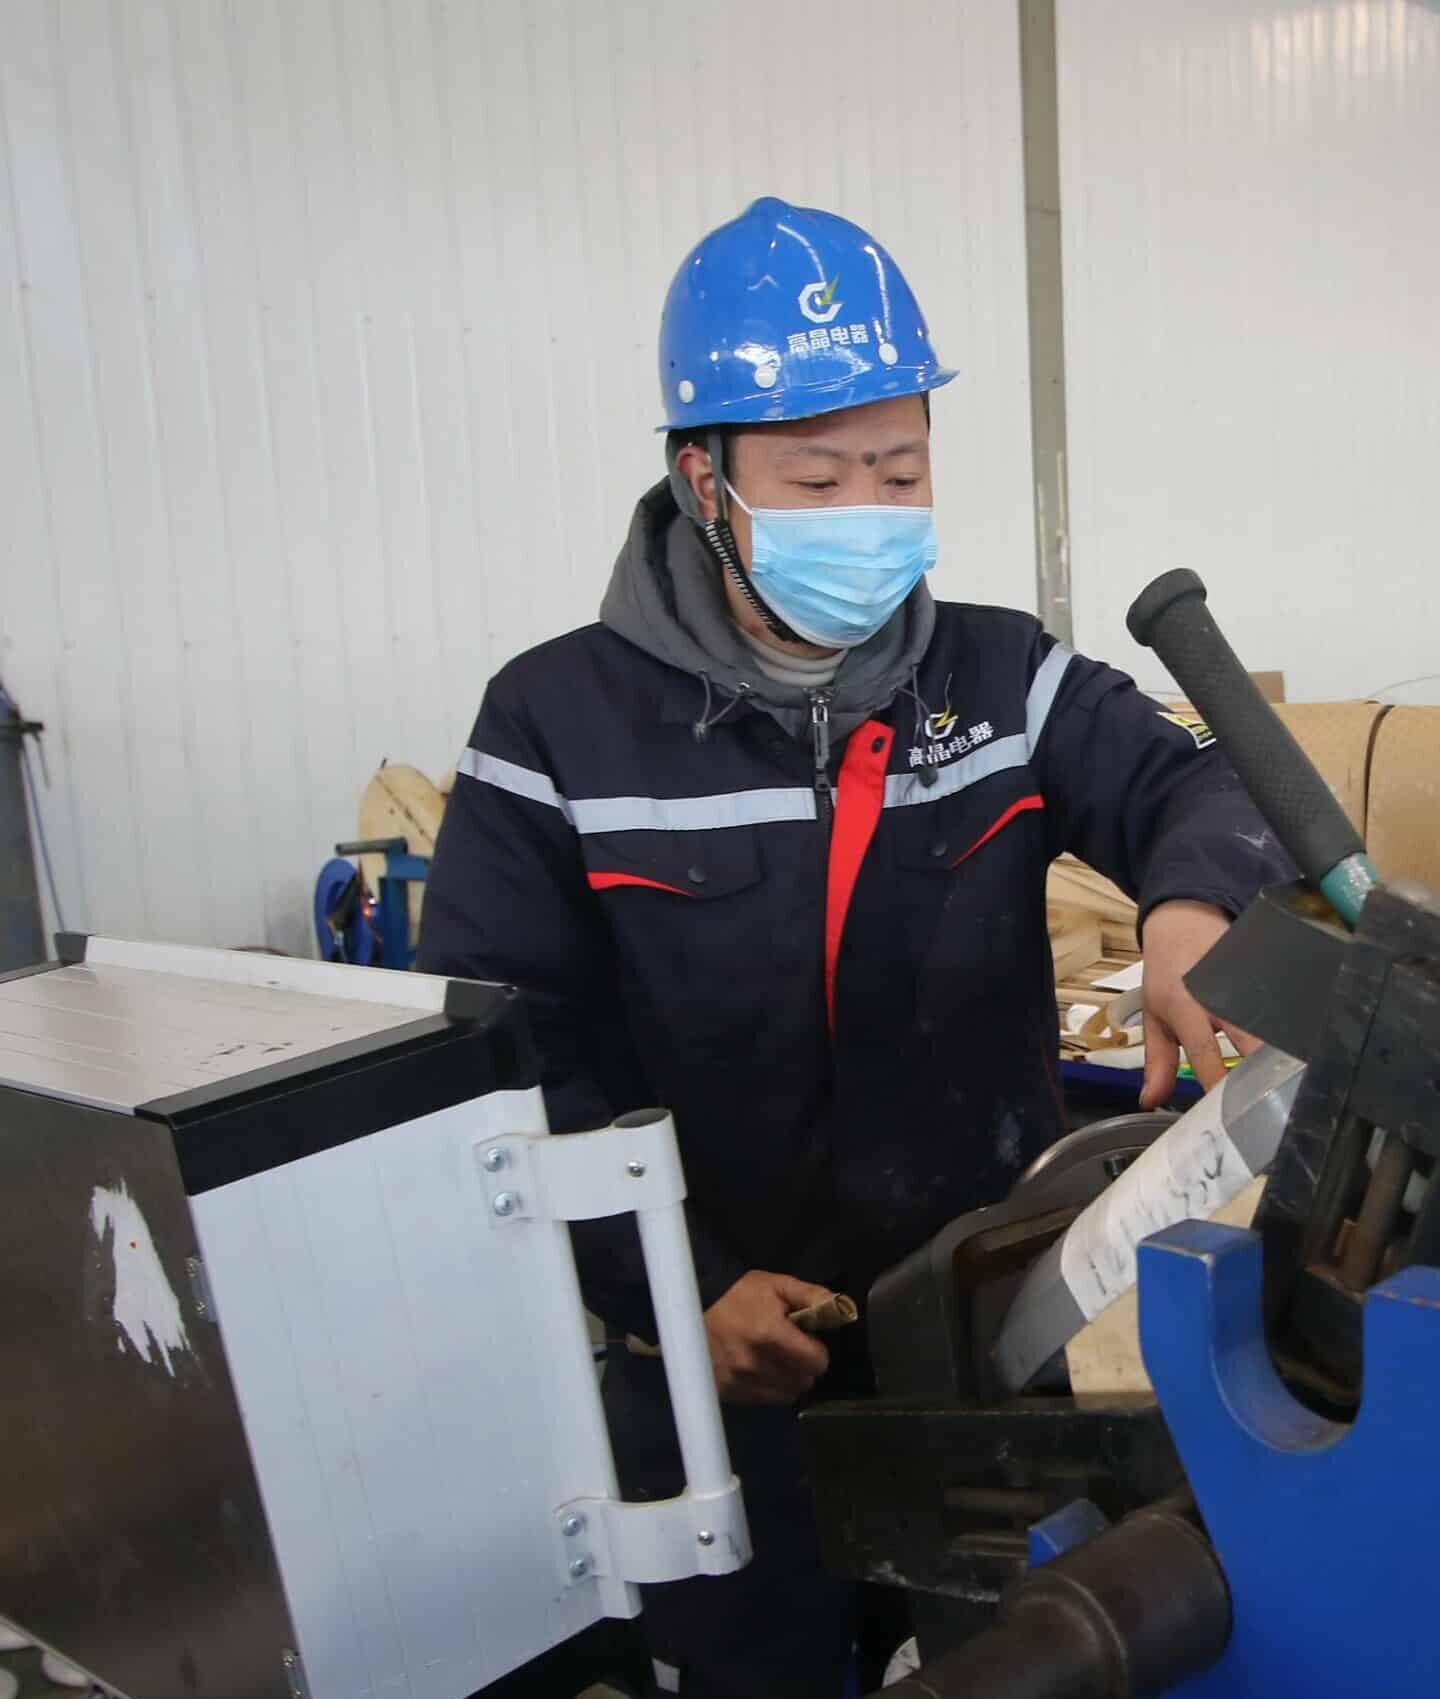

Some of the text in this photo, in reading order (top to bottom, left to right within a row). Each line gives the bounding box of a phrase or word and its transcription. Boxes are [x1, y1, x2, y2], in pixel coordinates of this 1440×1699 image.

[787, 325, 868, 353] 高晶电器
[907, 720, 994, 768] 高晶电器
